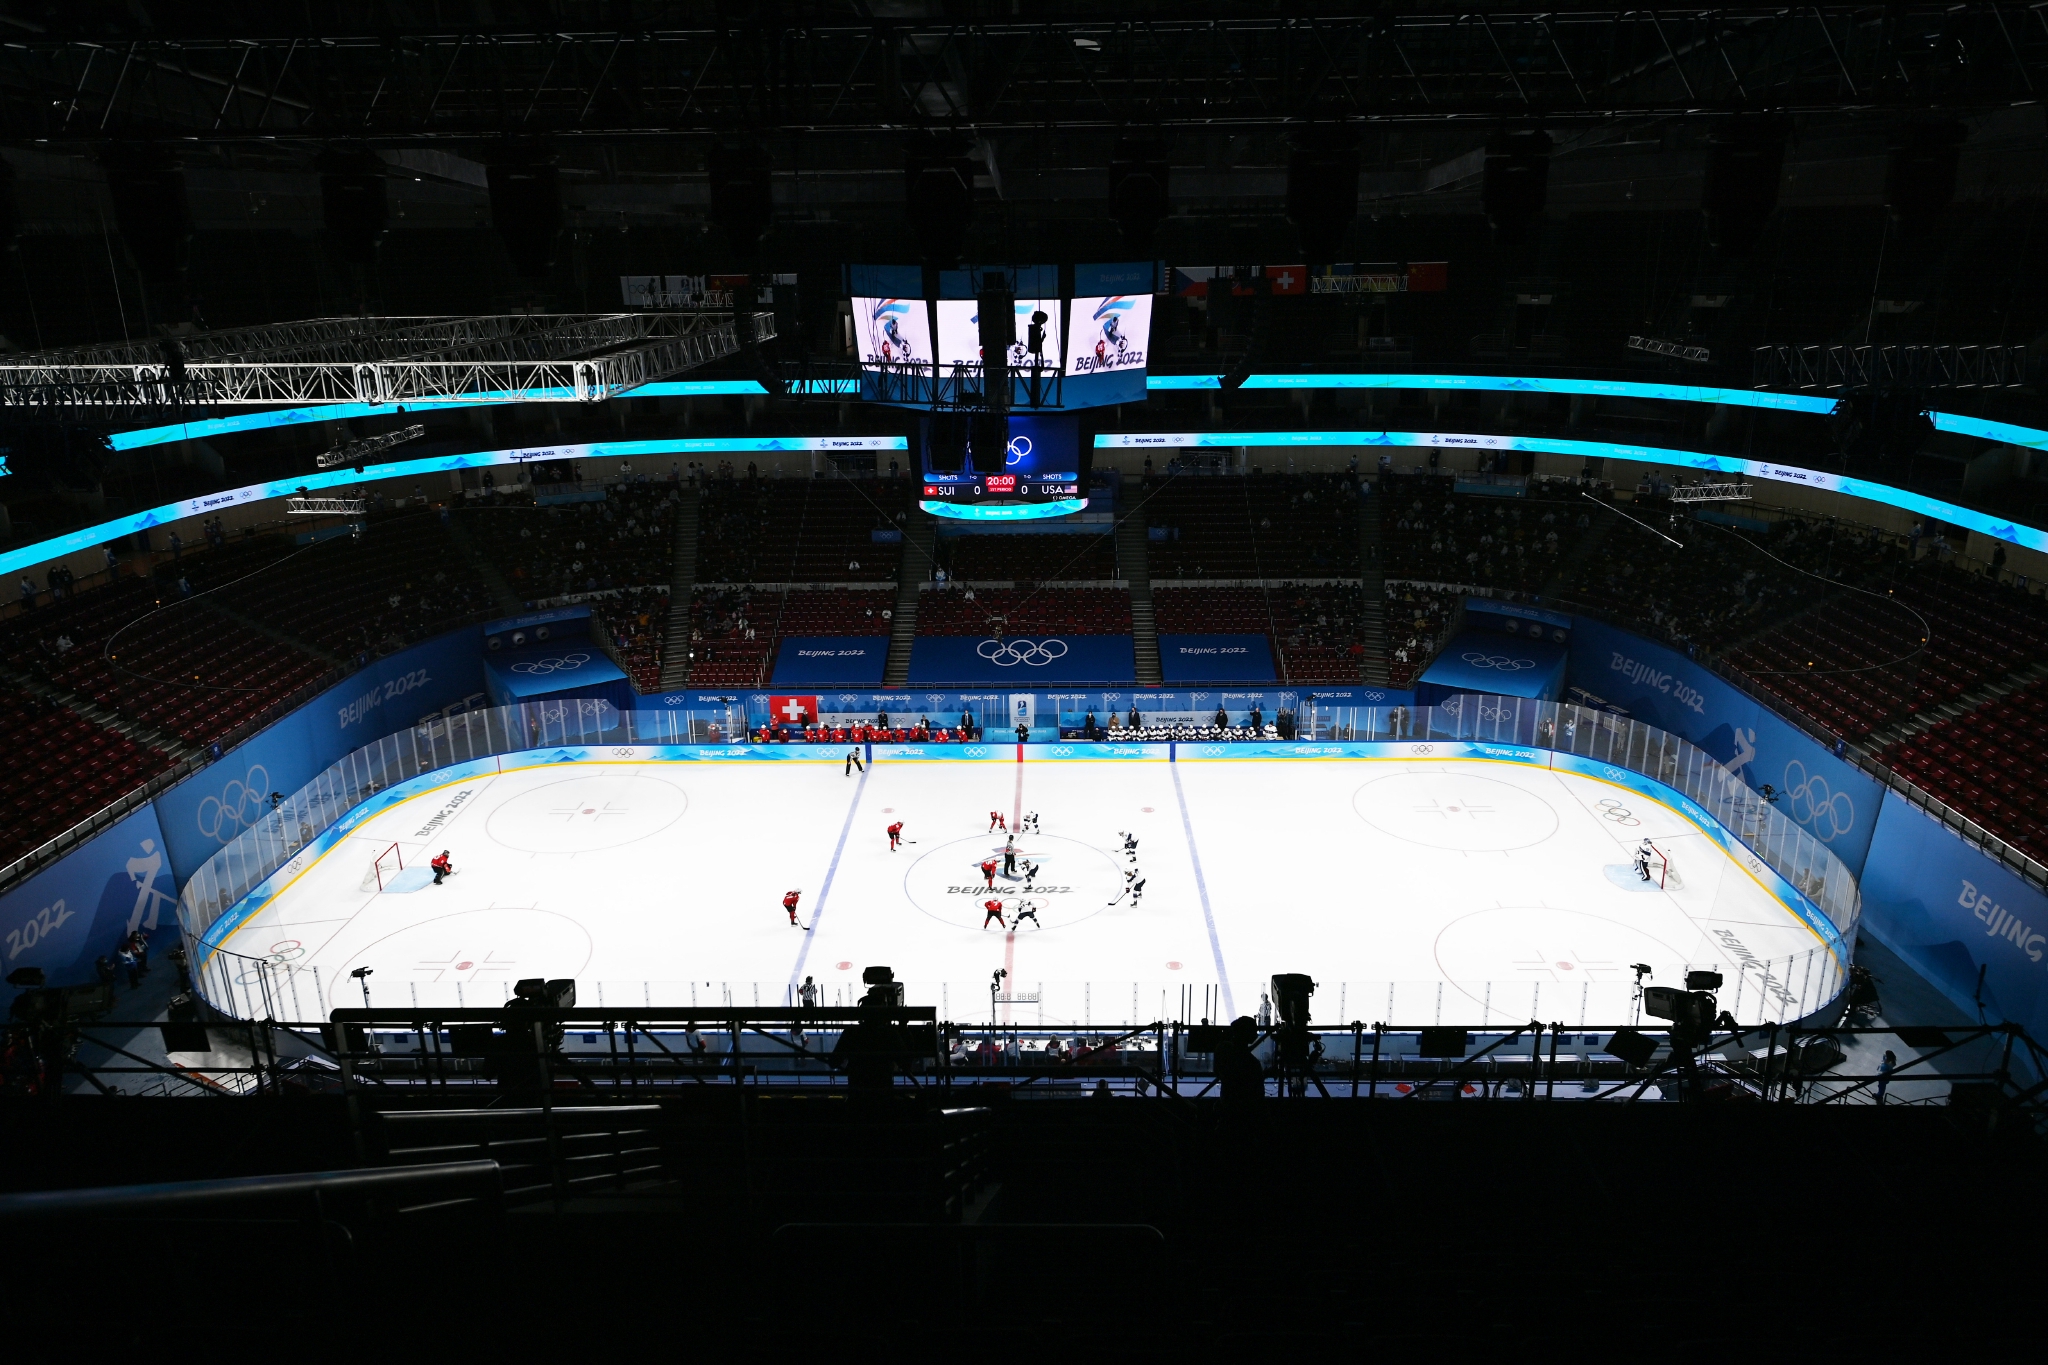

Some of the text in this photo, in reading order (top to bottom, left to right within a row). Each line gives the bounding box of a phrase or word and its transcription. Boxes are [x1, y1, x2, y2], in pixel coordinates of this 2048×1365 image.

[1075, 352, 1144, 373] BEIJING 2022
[938, 486, 955, 495] SUI
[974, 486, 980, 495] 0
[988, 477, 1014, 485] 20:00
[1021, 485, 1028, 494] 0
[1042, 485, 1063, 494] USA
[204, 498, 220, 507] BEIJING
[1610, 652, 1704, 715] BEIJING 2022
[338, 668, 432, 730] BEIJING 2022
[1485, 748, 1513, 756] BEIJING
[339, 807, 369, 832] BEIJING 2022
[414, 790, 474, 836] BEIJING 2022
[1682, 801, 1710, 828] BEIJING 2022
[947, 886, 1016, 896] BEIJING
[6, 898, 75, 960] 2022
[208, 912, 239, 945] BEIJING 2022
[1806, 908, 1825, 931] BEIJING
[1957, 879, 2047, 962] BEIJING
[1712, 930, 1798, 1006] BEIJING 2022
